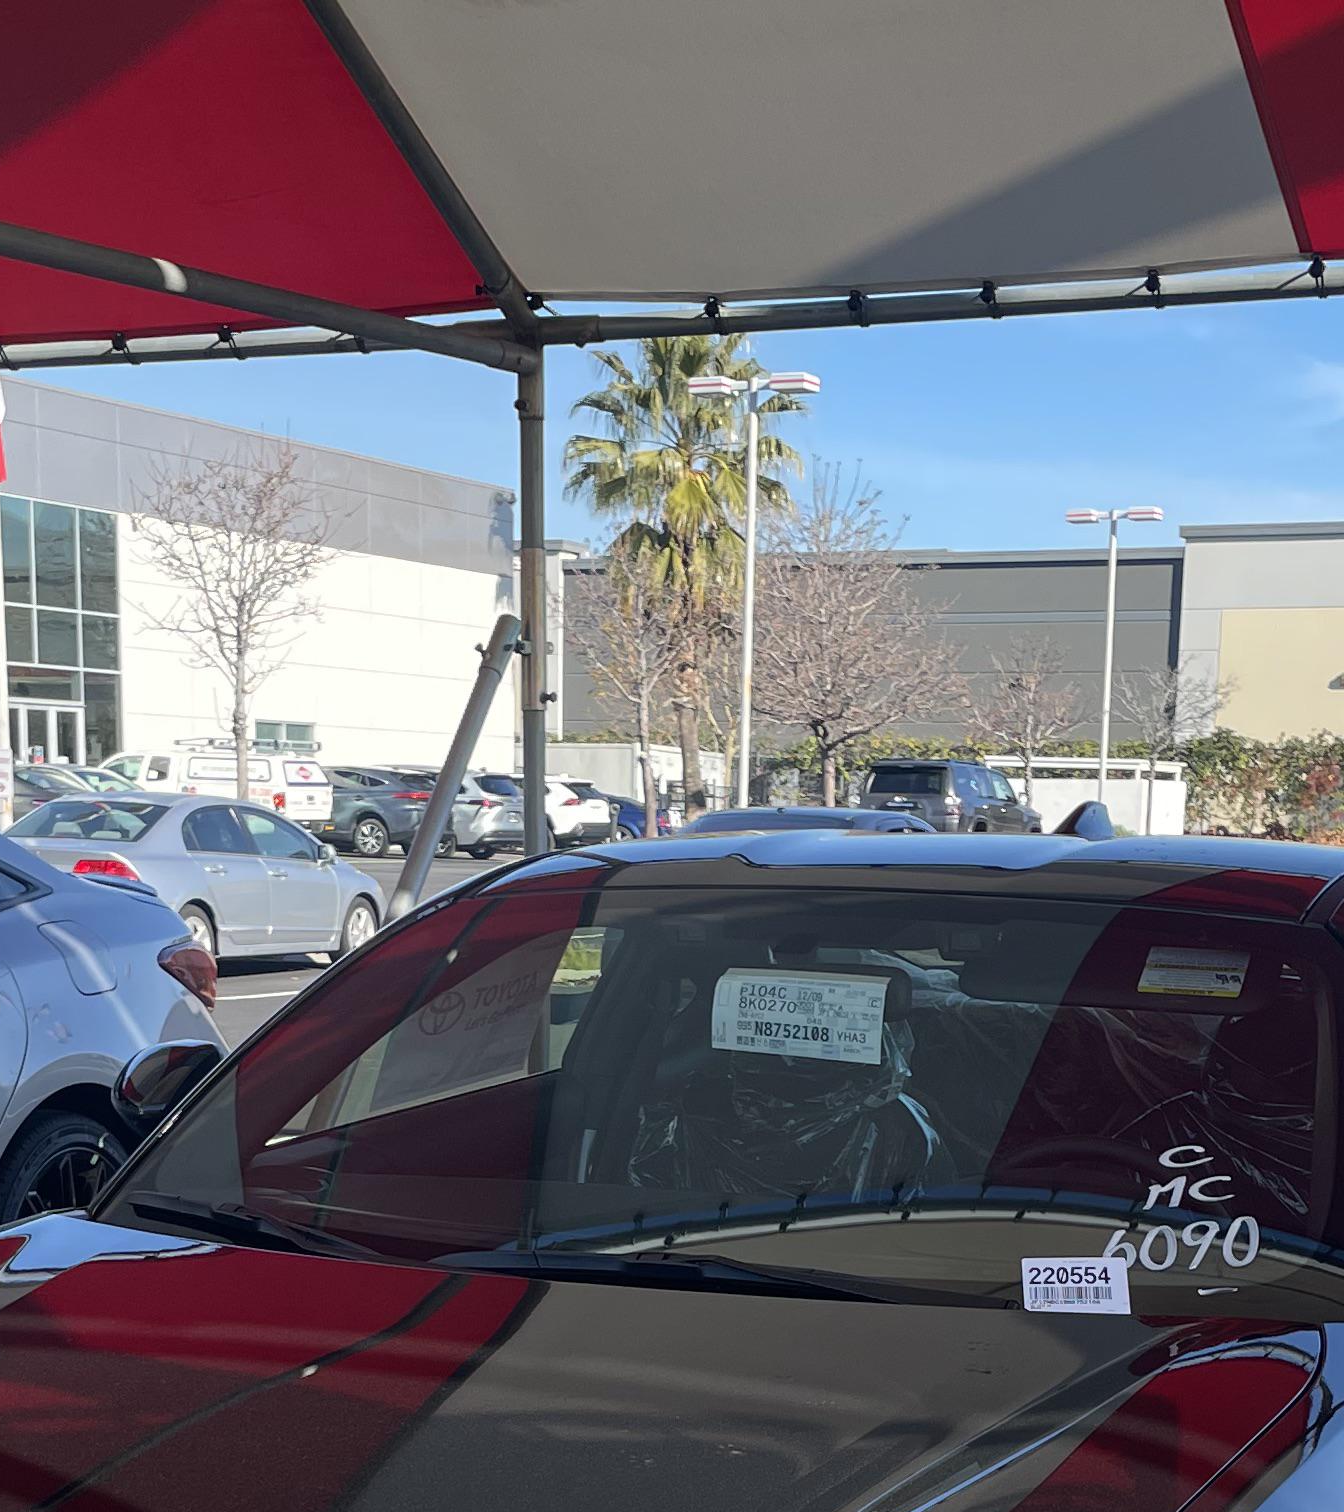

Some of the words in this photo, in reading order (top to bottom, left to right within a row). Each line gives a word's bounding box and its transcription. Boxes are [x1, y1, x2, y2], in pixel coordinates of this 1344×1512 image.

[755, 1021, 830, 1042] N8752108
[836, 1031, 867, 1044] YHA3
[1102, 1216, 1260, 1271] 6090
[1028, 1266, 1112, 1285] 220554
